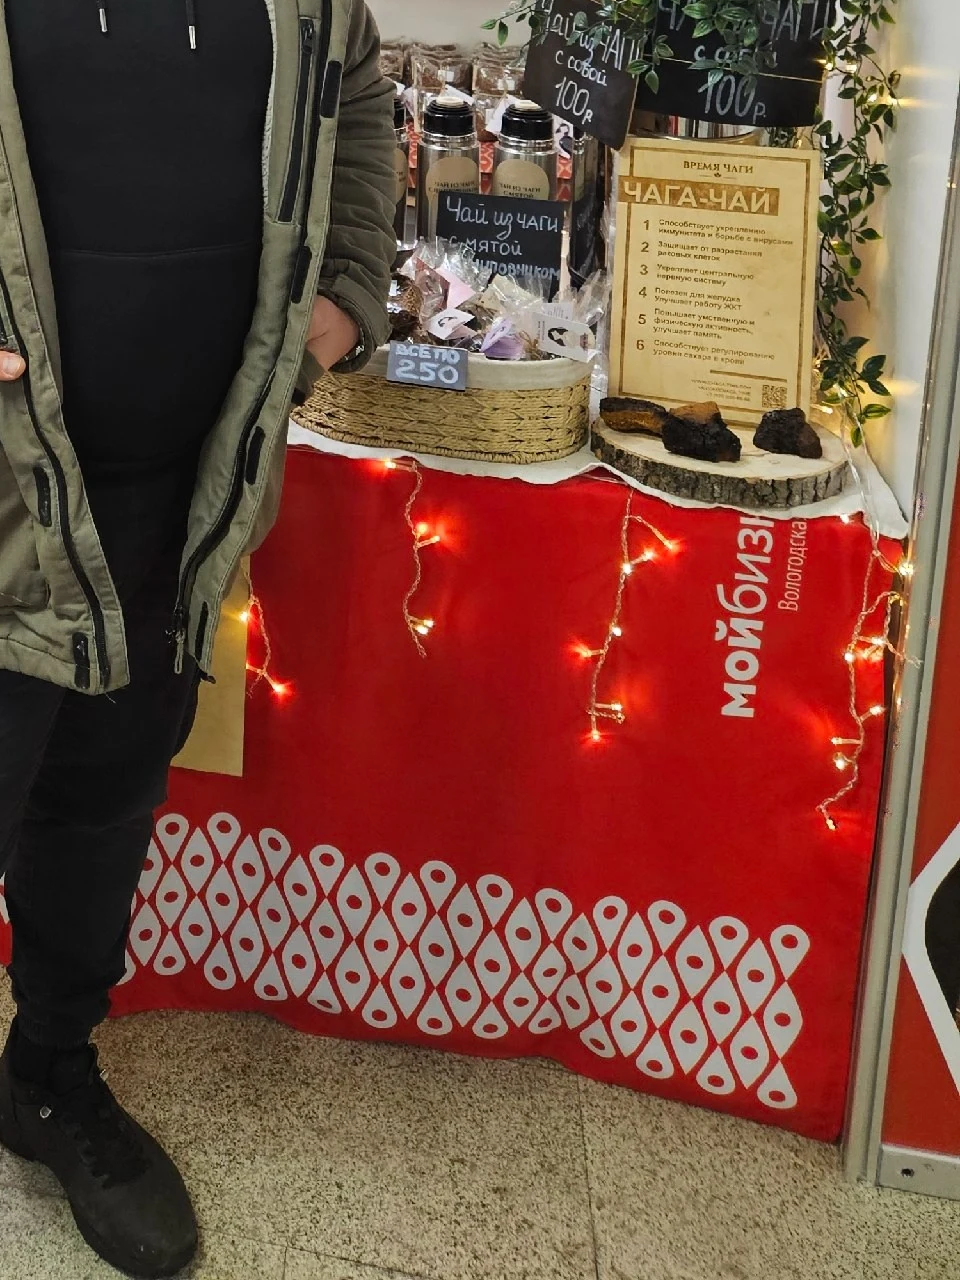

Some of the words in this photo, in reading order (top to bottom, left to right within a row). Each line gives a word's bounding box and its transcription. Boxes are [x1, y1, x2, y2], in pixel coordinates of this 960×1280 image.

[683, 160, 720, 172] ВРЕМЯ
[723, 163, 754, 174] ЧАГИ
[623, 181, 770, 214] ЧАГА-ЧАЙ
[446, 195, 489, 224] Чай
[493, 212, 513, 240] из
[642, 219, 650, 231] 1
[640, 241, 649, 253] 2
[658, 240, 699, 251] Защищает
[639, 264, 649, 275] 3
[693, 277, 727, 287] систему
[638, 286, 647, 298] 4
[694, 300, 722, 311] работу
[723, 303, 743, 311] ЖКТ
[638, 313, 647, 325] 5
[636, 339, 645, 351] 6
[433, 348, 461, 365] ПО
[394, 358, 460, 385] 250
